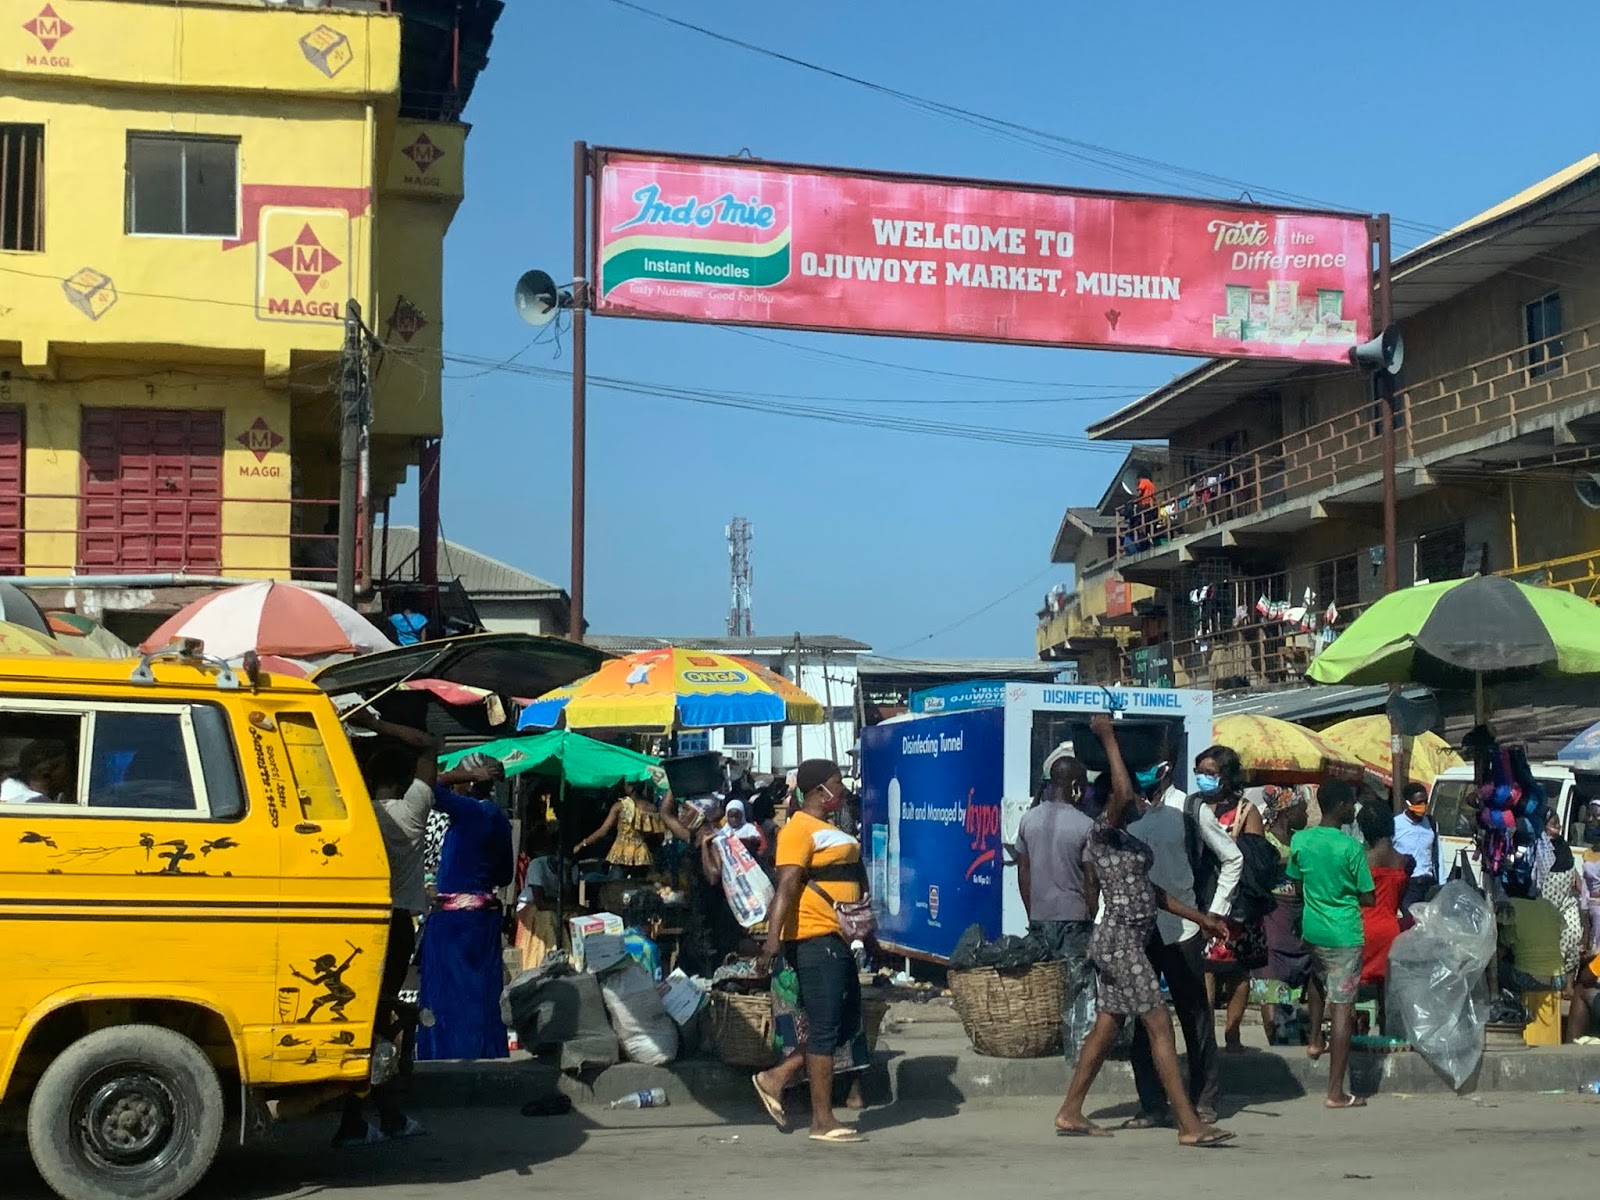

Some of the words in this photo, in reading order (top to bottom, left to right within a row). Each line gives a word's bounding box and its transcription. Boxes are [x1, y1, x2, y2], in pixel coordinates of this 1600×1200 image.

[39, 19, 58, 35] M
[26, 55, 70, 67] MAGGI
[404, 176, 440, 187] MAGGI
[872, 218, 1025, 255] WELCOME
[1035, 229, 1074, 258] TO
[1207, 219, 1270, 251] Taste
[1291, 231, 1315, 245] the
[296, 246, 319, 272] M
[643, 257, 691, 275] Instant
[694, 262, 750, 279] Noodles
[1231, 251, 1347, 271] Difference
[801, 252, 937, 286] OJUWOYE
[945, 262, 1068, 297] MARKET,
[1075, 271, 1181, 301] MUSHIN
[709, 291, 735, 301] Good
[268, 298, 340, 318] MAGGI
[239, 466, 280, 478] MAGGI
[686, 672, 743, 683] ONGA
[1134, 693, 1183, 709] TUNNEL
[902, 733, 938, 758] Disinfecting
[939, 729, 963, 752] Tunnel
[902, 802, 914, 819] Built
[915, 802, 926, 820] and
[927, 803, 957, 826] Managed
[958, 800, 967, 827] by
